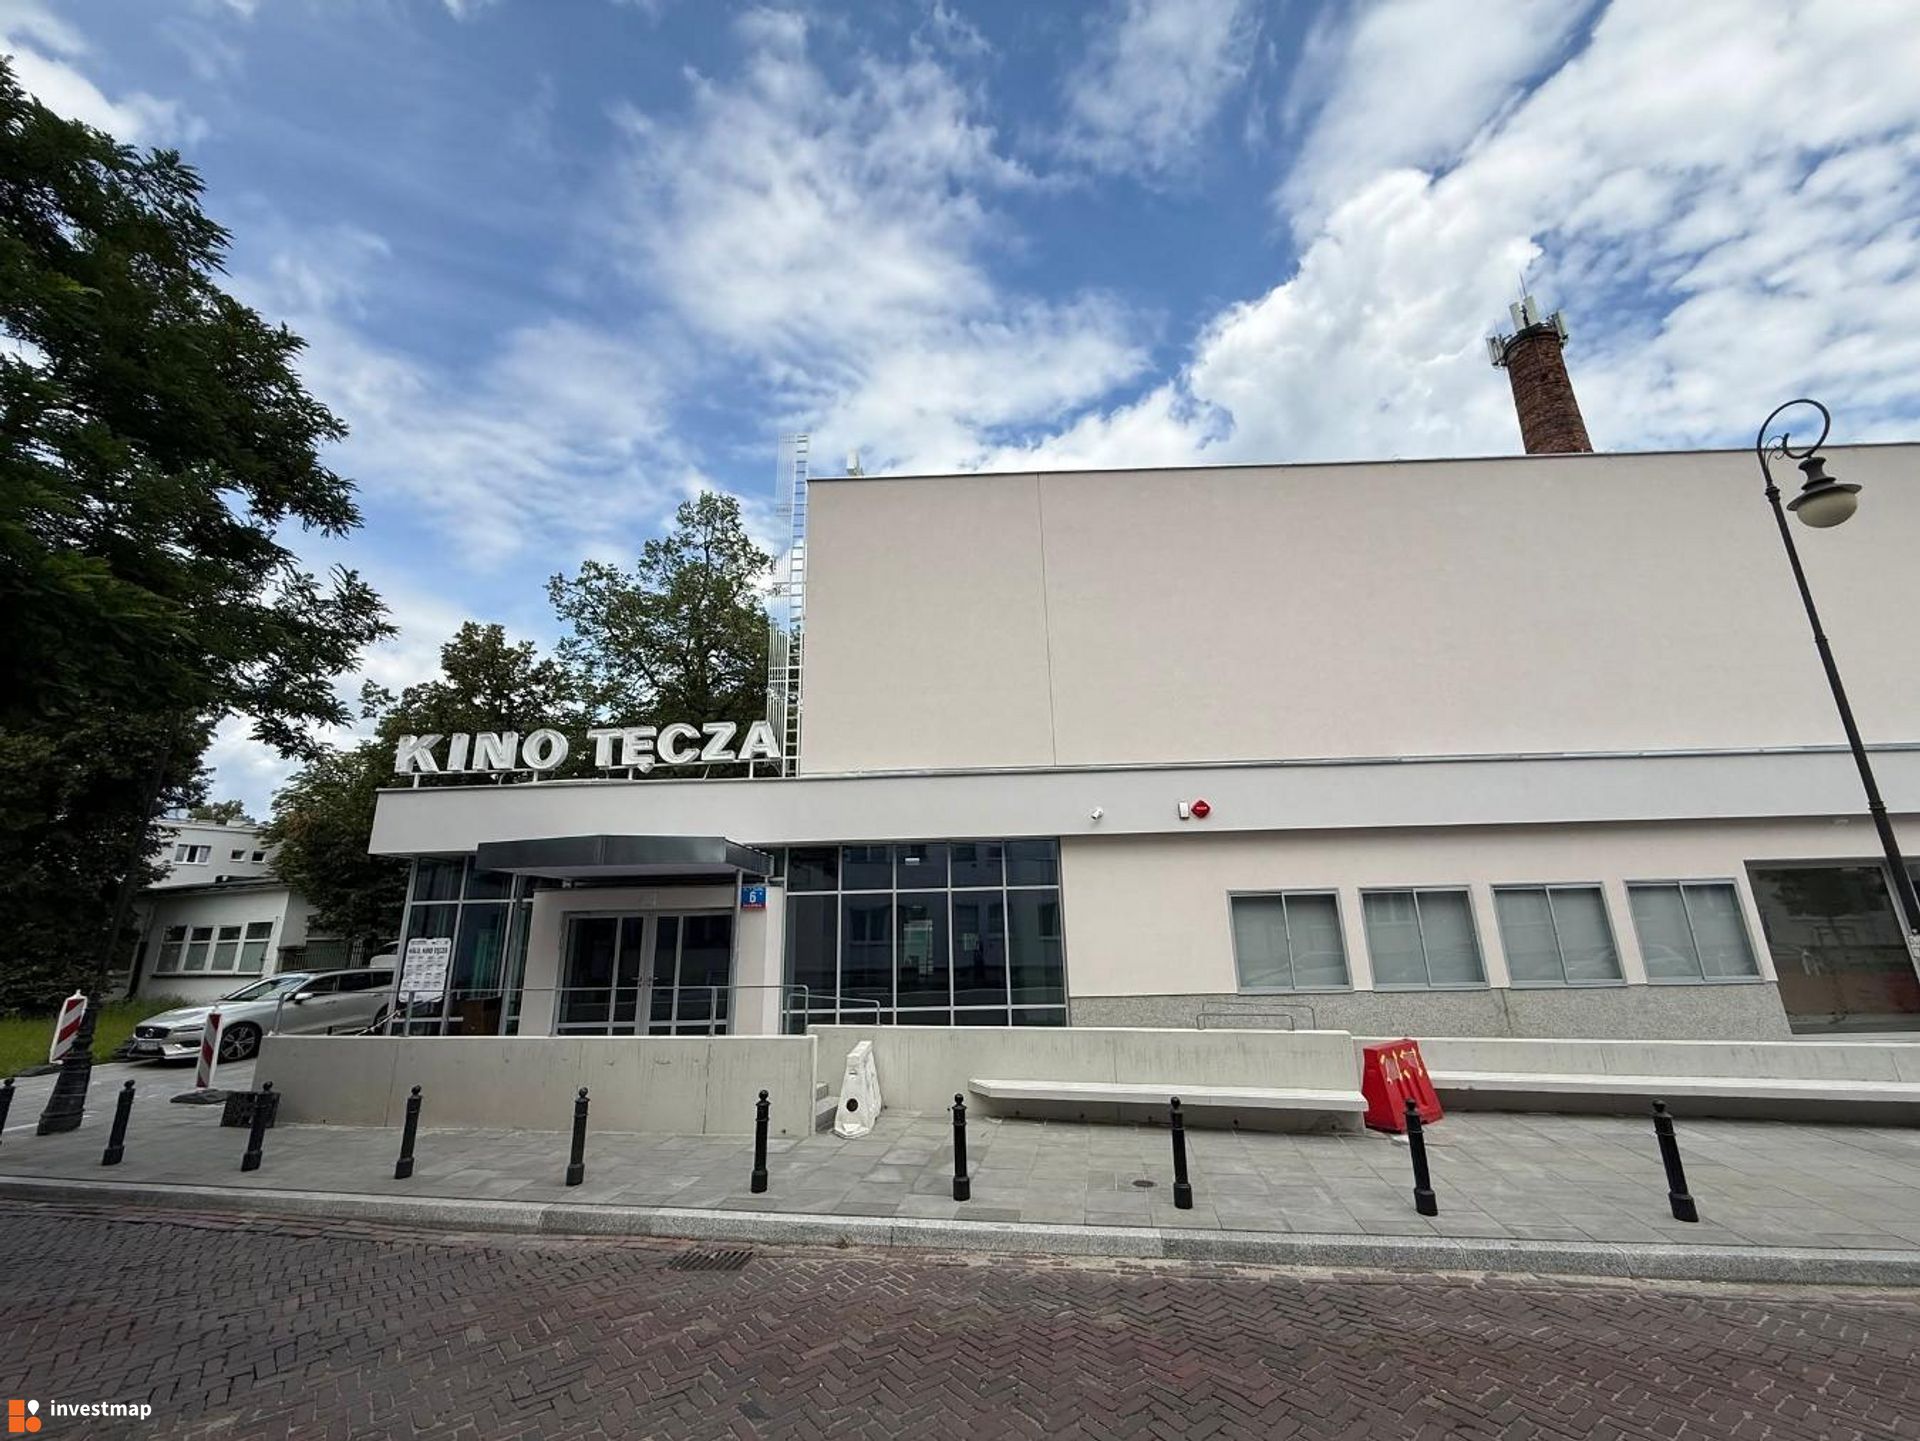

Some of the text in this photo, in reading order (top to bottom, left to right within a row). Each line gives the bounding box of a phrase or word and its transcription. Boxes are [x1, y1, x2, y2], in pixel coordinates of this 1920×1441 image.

[394, 720, 781, 773] KINO TĘCZA
[749, 891, 757, 903] 6
